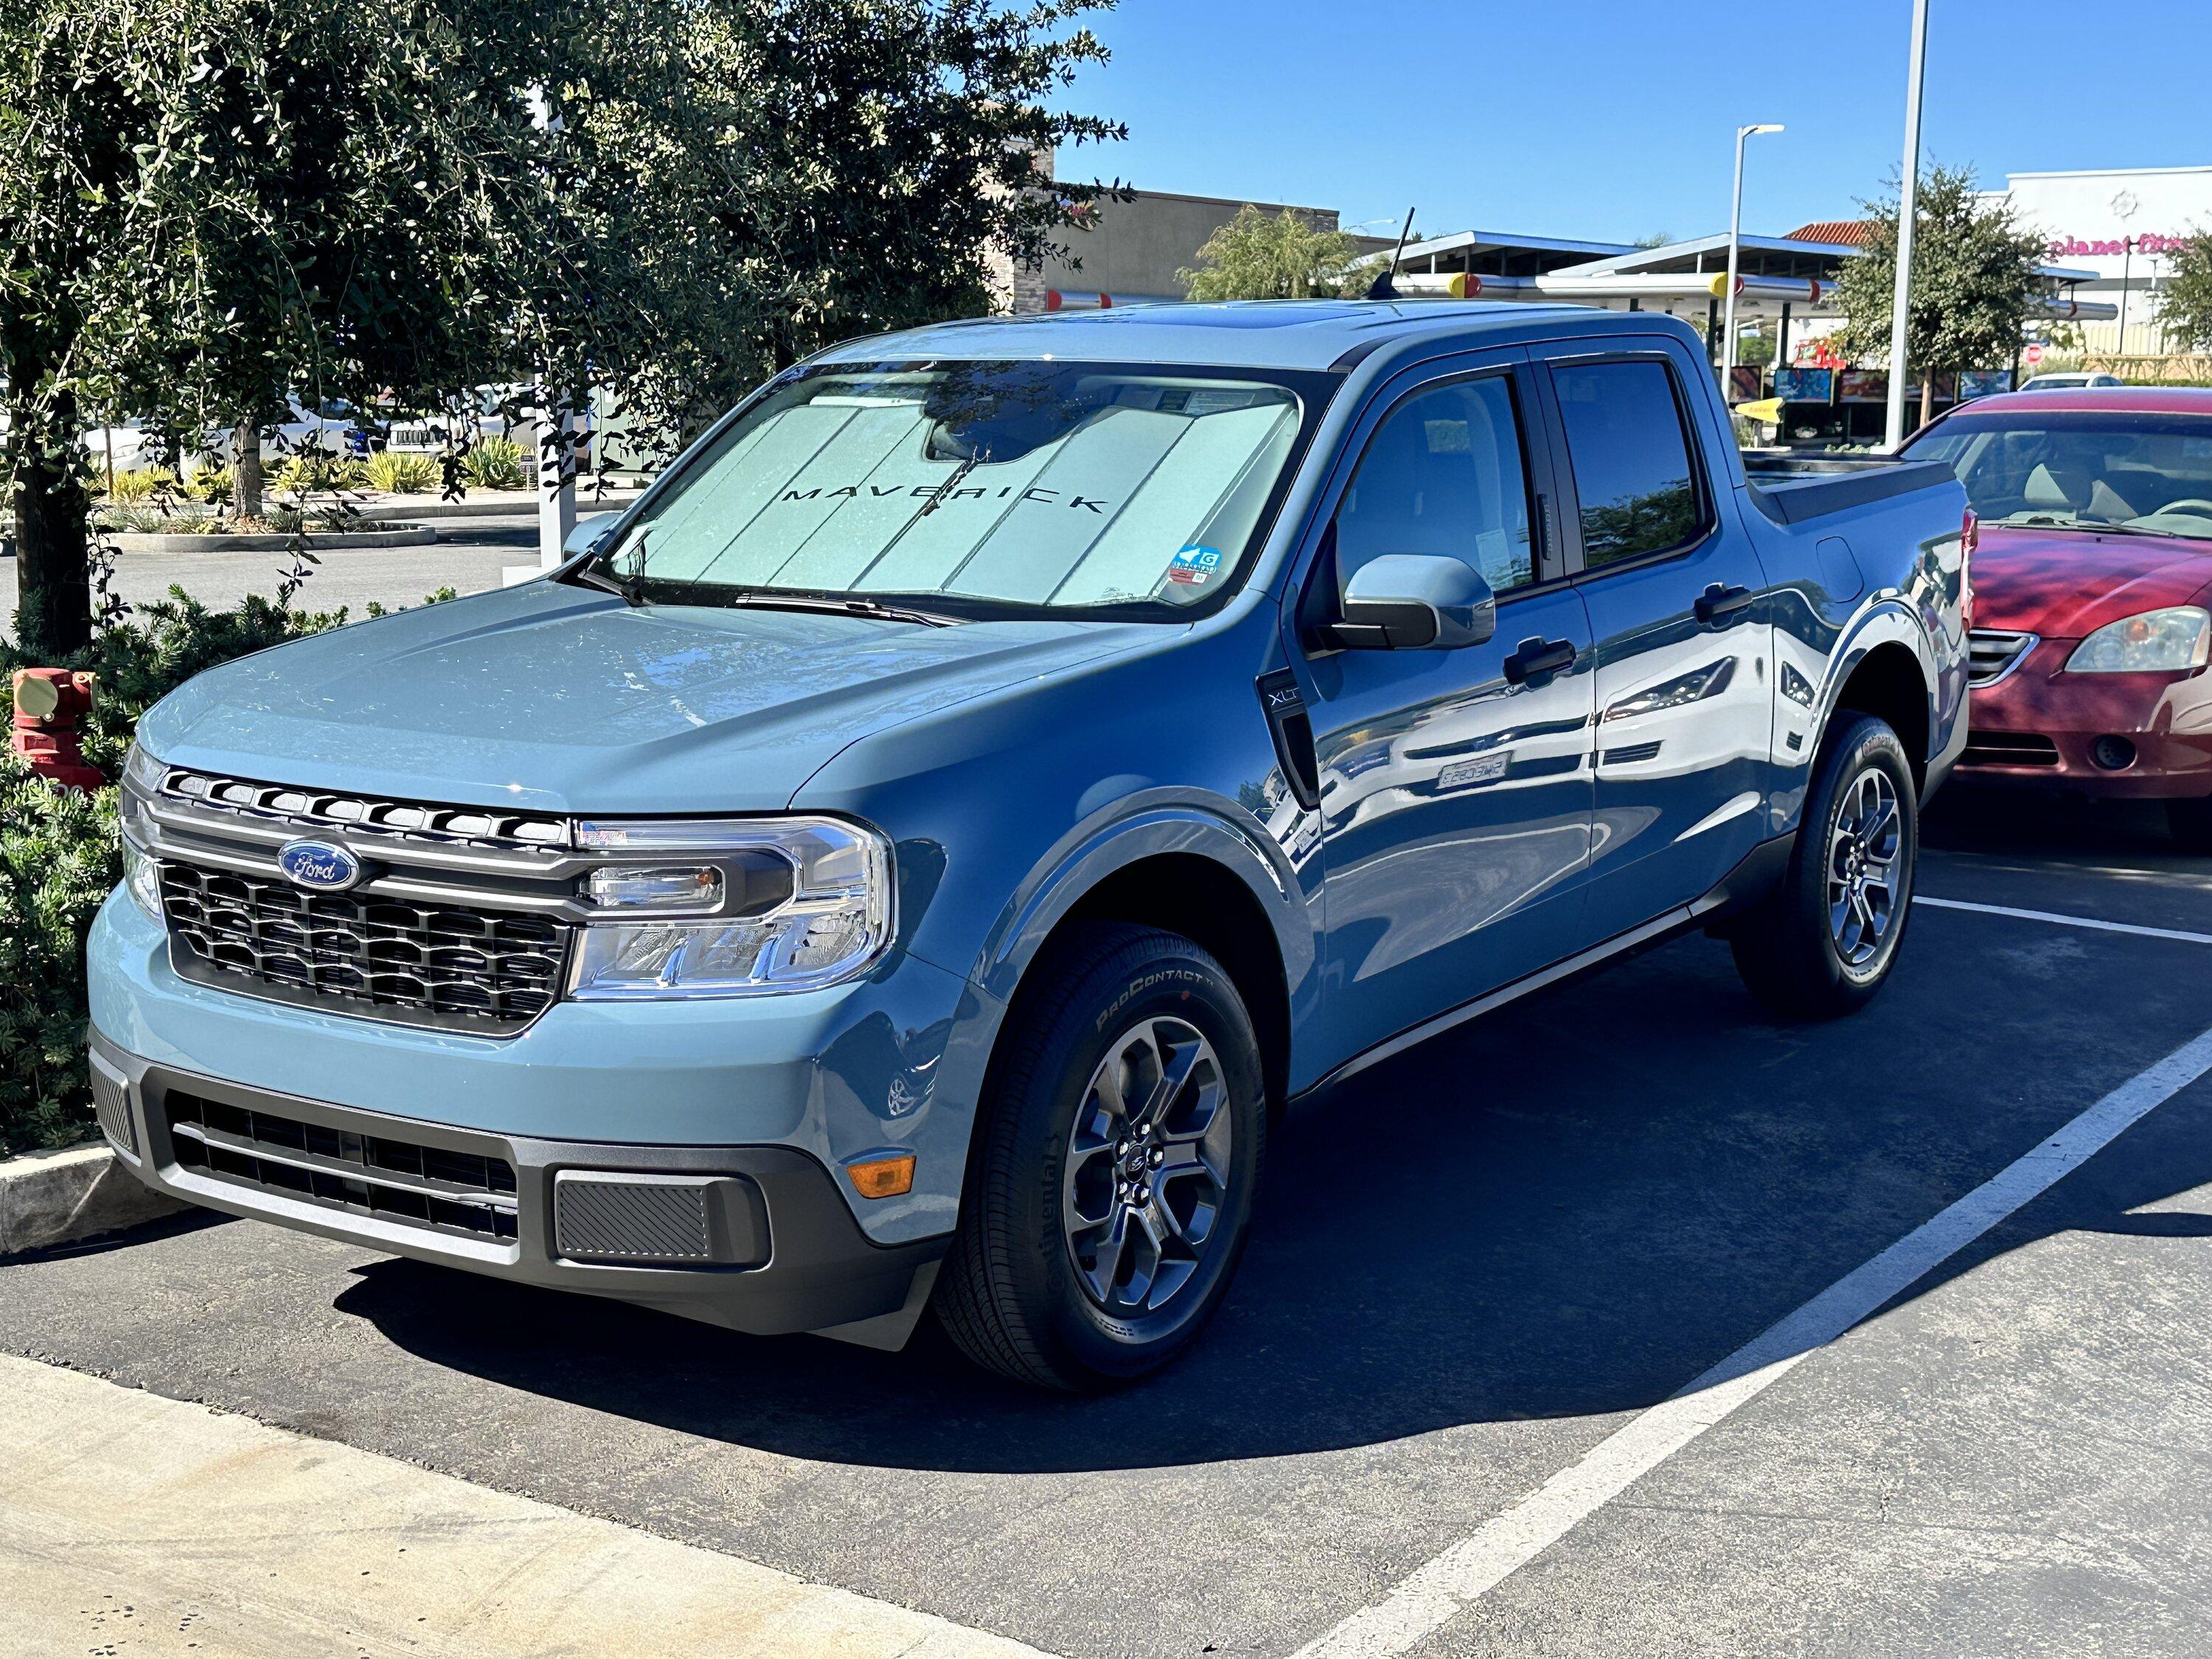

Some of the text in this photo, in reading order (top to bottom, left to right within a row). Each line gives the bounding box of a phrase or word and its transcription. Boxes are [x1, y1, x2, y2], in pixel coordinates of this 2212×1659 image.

[782, 486, 1110, 514] MAVERICK
[1268, 686, 1299, 706] XLT
[293, 852, 336, 880] Ford
